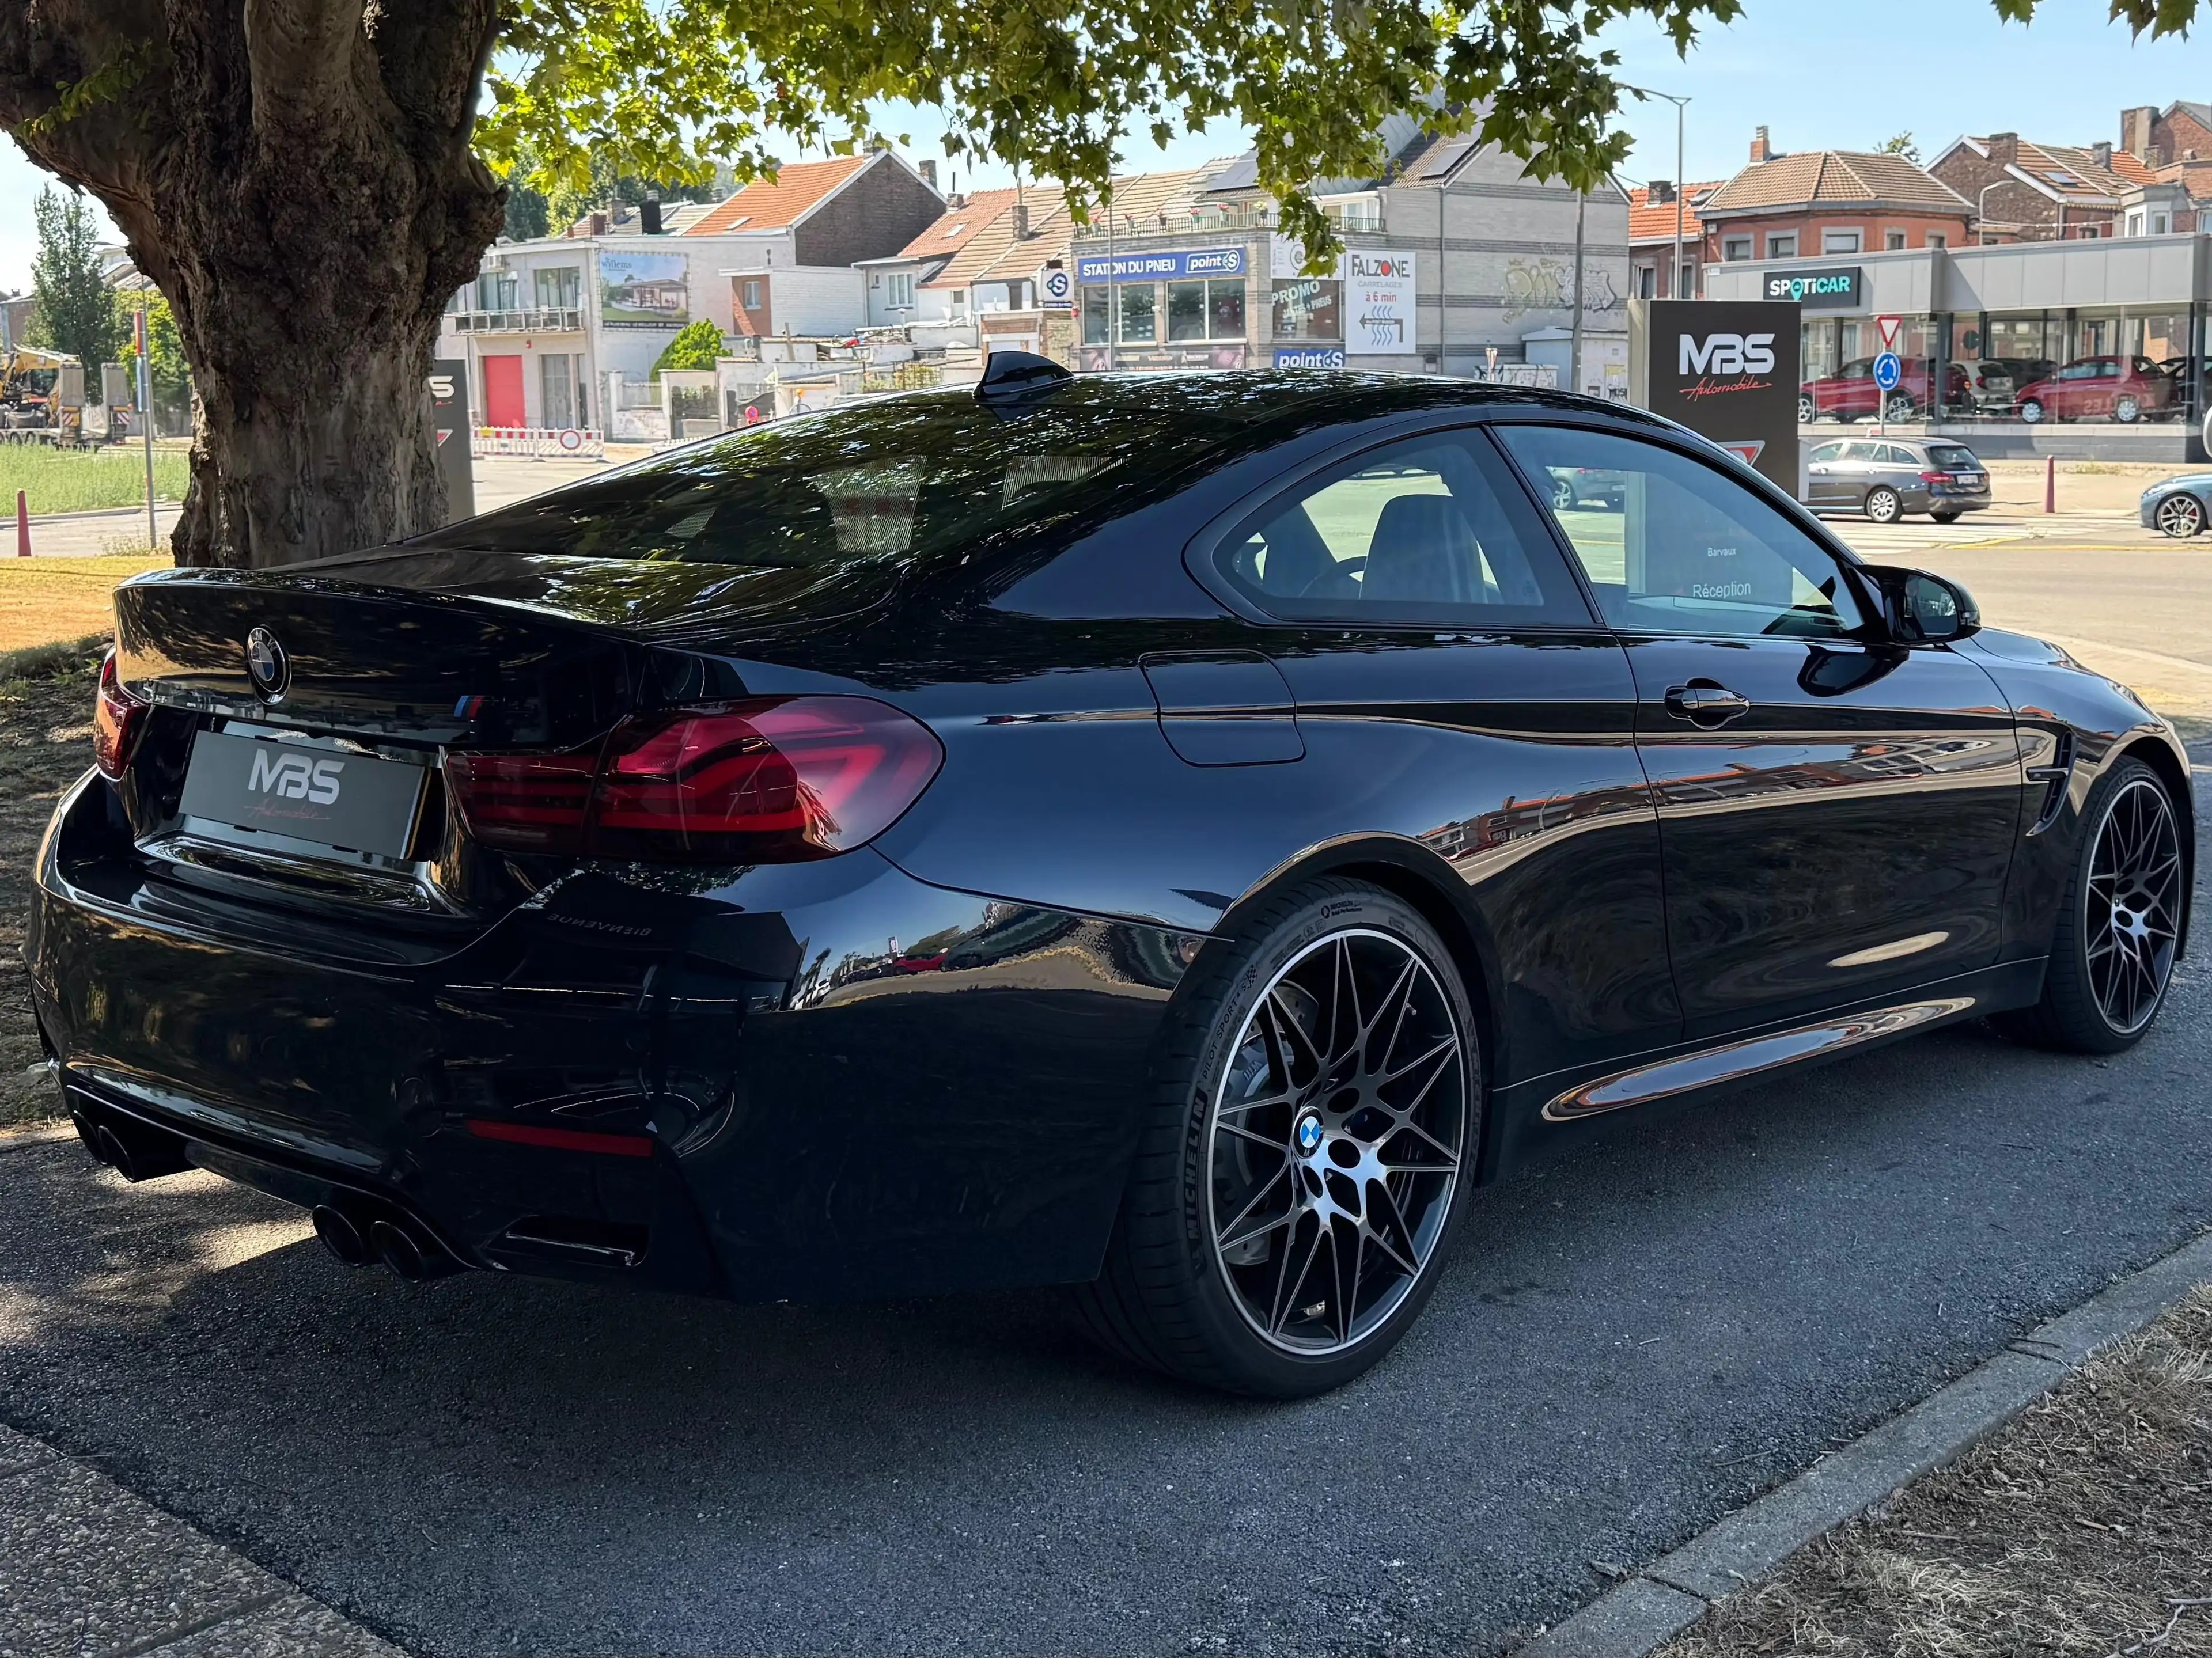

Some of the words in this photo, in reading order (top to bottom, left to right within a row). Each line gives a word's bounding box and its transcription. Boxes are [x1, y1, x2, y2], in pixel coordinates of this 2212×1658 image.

[1129, 261, 1143, 274] DU
[1146, 258, 1176, 272] PNEU
[1190, 255, 1222, 270] point
[1352, 255, 1410, 279] FALZONE
[1272, 280, 1320, 306] PROMO
[1310, 295, 1332, 310] PNEUS
[1365, 291, 1370, 302] à
[1373, 291, 1378, 302] 6
[1381, 292, 1397, 302] min
[1279, 352, 1323, 367] point
[1679, 333, 1775, 375] MBS
[1679, 375, 1772, 401] Automobile
[1707, 547, 1736, 556] Barvaux
[1693, 581, 1751, 599] Réception
[248, 748, 345, 805] MBS
[1202, 1042, 1218, 1079] PILOT
[1217, 999, 1237, 1038] SPORT
[1241, 982, 1247, 991] S
[1185, 1095, 1206, 1239] MICHELIN
